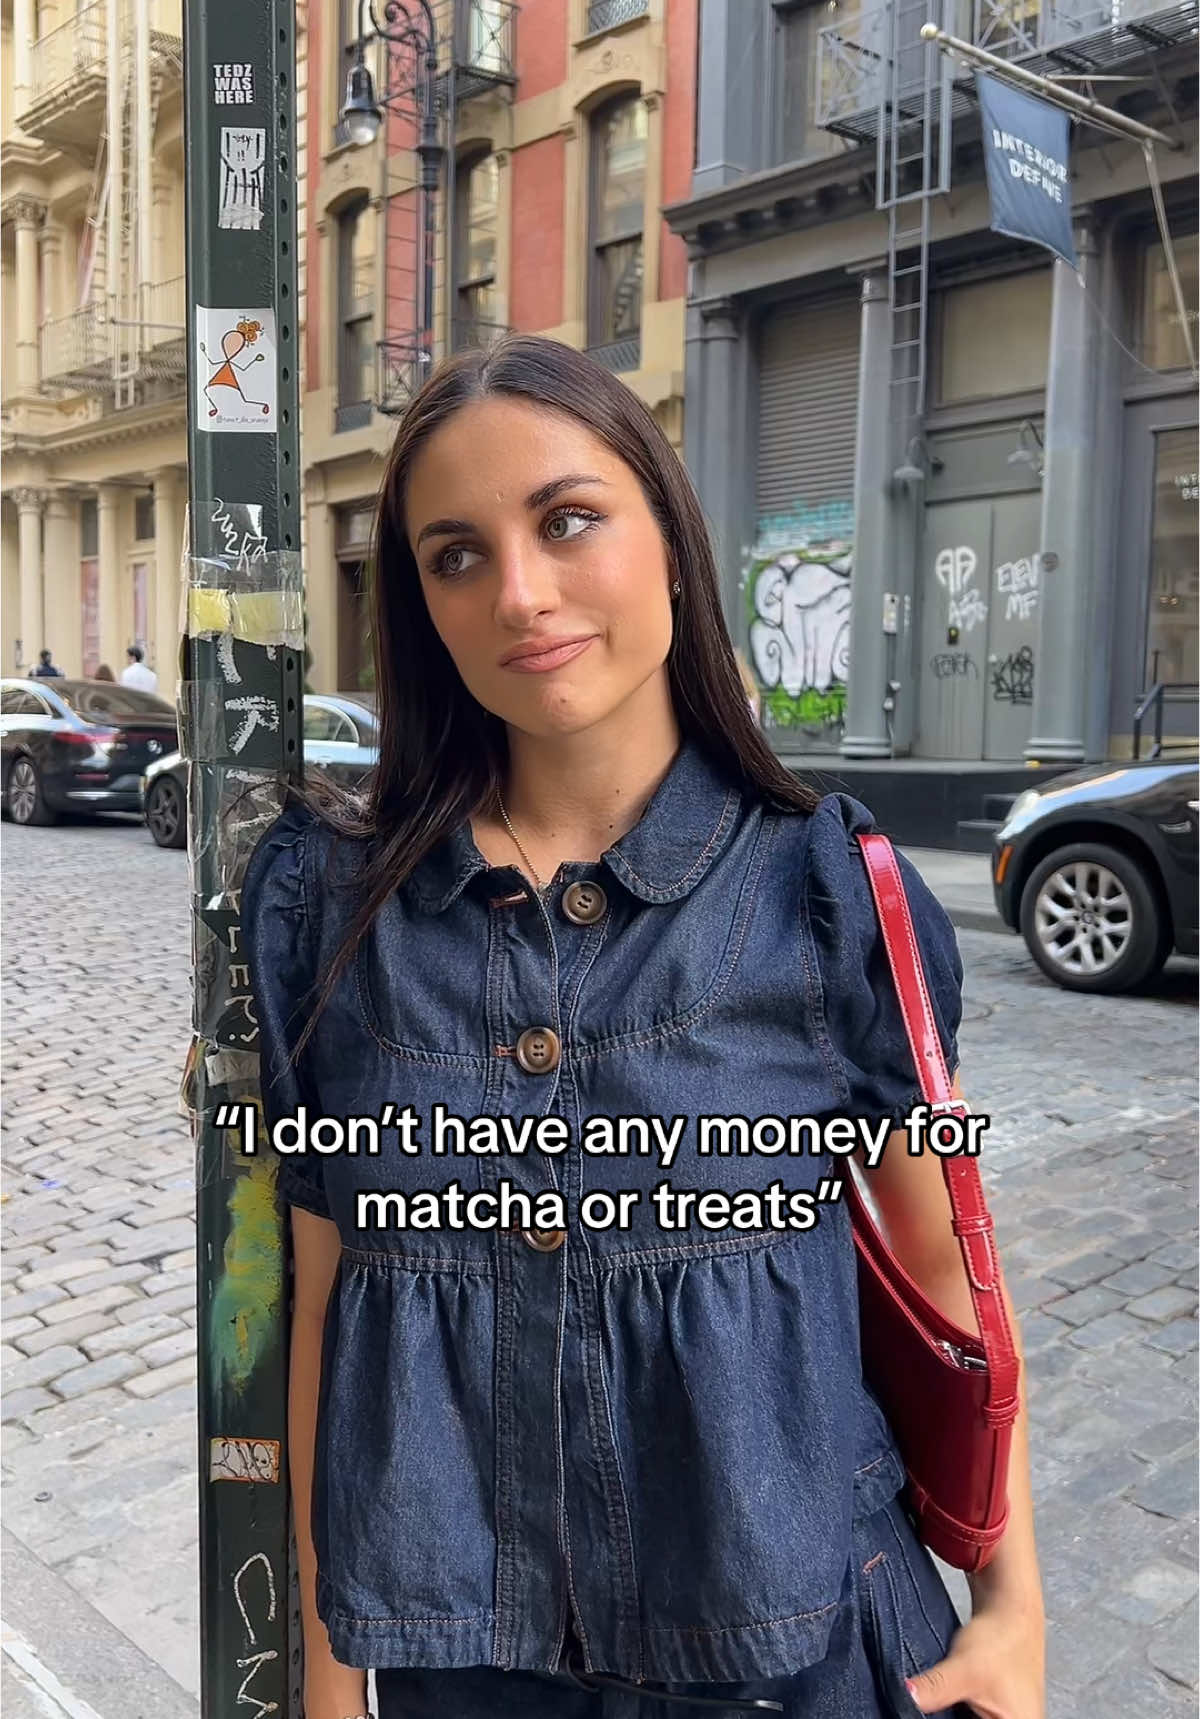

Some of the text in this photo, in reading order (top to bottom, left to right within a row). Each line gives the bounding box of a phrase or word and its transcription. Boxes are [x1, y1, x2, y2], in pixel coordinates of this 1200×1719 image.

[213, 64, 252, 77] TEDZ
[214, 77, 252, 91] WAS
[215, 90, 254, 104] HERE
